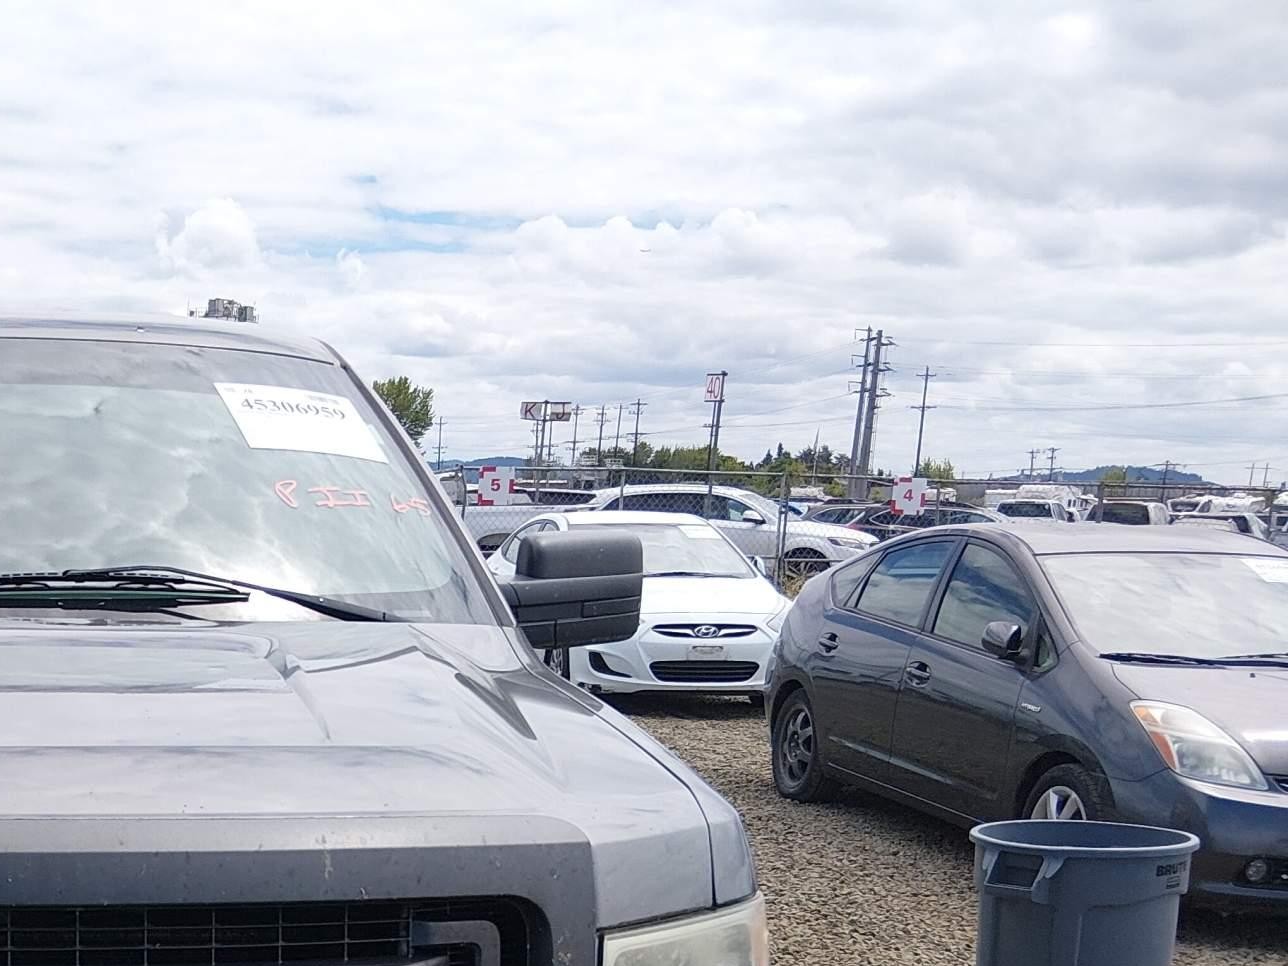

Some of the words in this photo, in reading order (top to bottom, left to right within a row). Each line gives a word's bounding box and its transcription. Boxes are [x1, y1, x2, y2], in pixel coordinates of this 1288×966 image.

[706, 376, 721, 399] 40
[241, 398, 346, 420] 45306959
[524, 402, 537, 419] K
[555, 402, 566, 420] J
[490, 478, 501, 492] 5
[903, 488, 914, 502] 4
